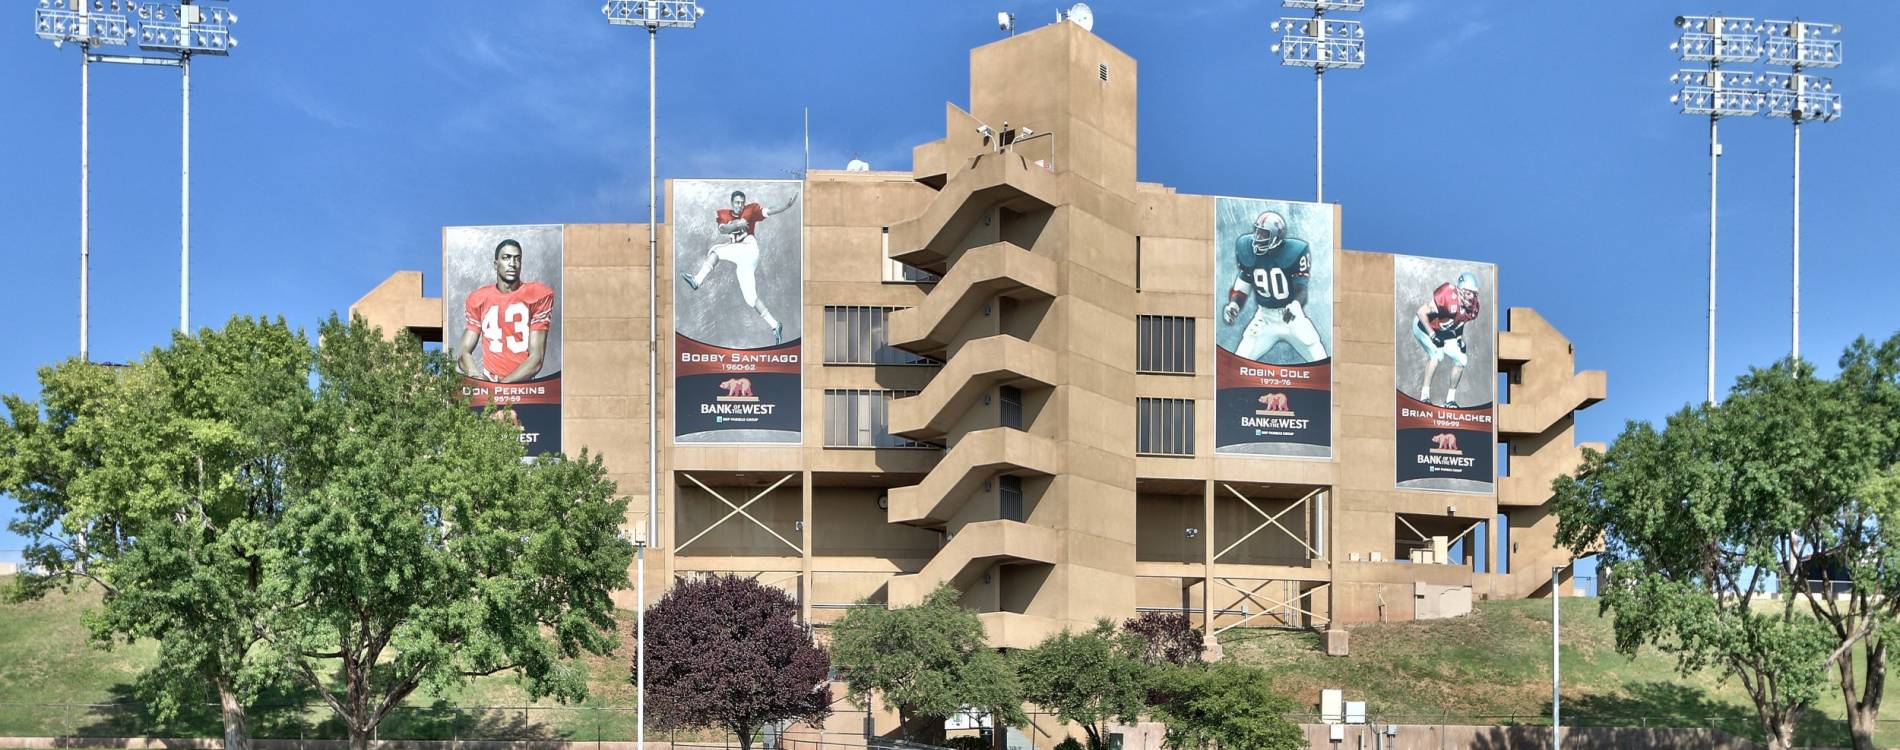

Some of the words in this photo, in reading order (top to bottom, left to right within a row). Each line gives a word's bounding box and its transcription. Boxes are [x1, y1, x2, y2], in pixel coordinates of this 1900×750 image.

[1253, 267, 1290, 300] 90
[482, 302, 529, 353] 43
[681, 352, 725, 362] BOBBY
[731, 353, 798, 363] SANTIAGO
[722, 363, 756, 371] 1960-62
[1240, 367, 1275, 378] ROBIN
[1280, 369, 1310, 379] COLE
[1261, 378, 1292, 386] 1973-76
[462, 386, 489, 396] DON
[494, 386, 545, 395] PERKINS
[701, 403, 732, 414] BANK
[742, 404, 776, 415] WEST
[1402, 408, 1433, 418] BRIAN
[1438, 411, 1492, 423] URLACHER
[1241, 416, 1270, 427] BANK
[1279, 418, 1310, 429] WEST
[516, 432, 540, 443] EST
[1417, 454, 1442, 465] BANK
[1449, 456, 1476, 467] WEST
